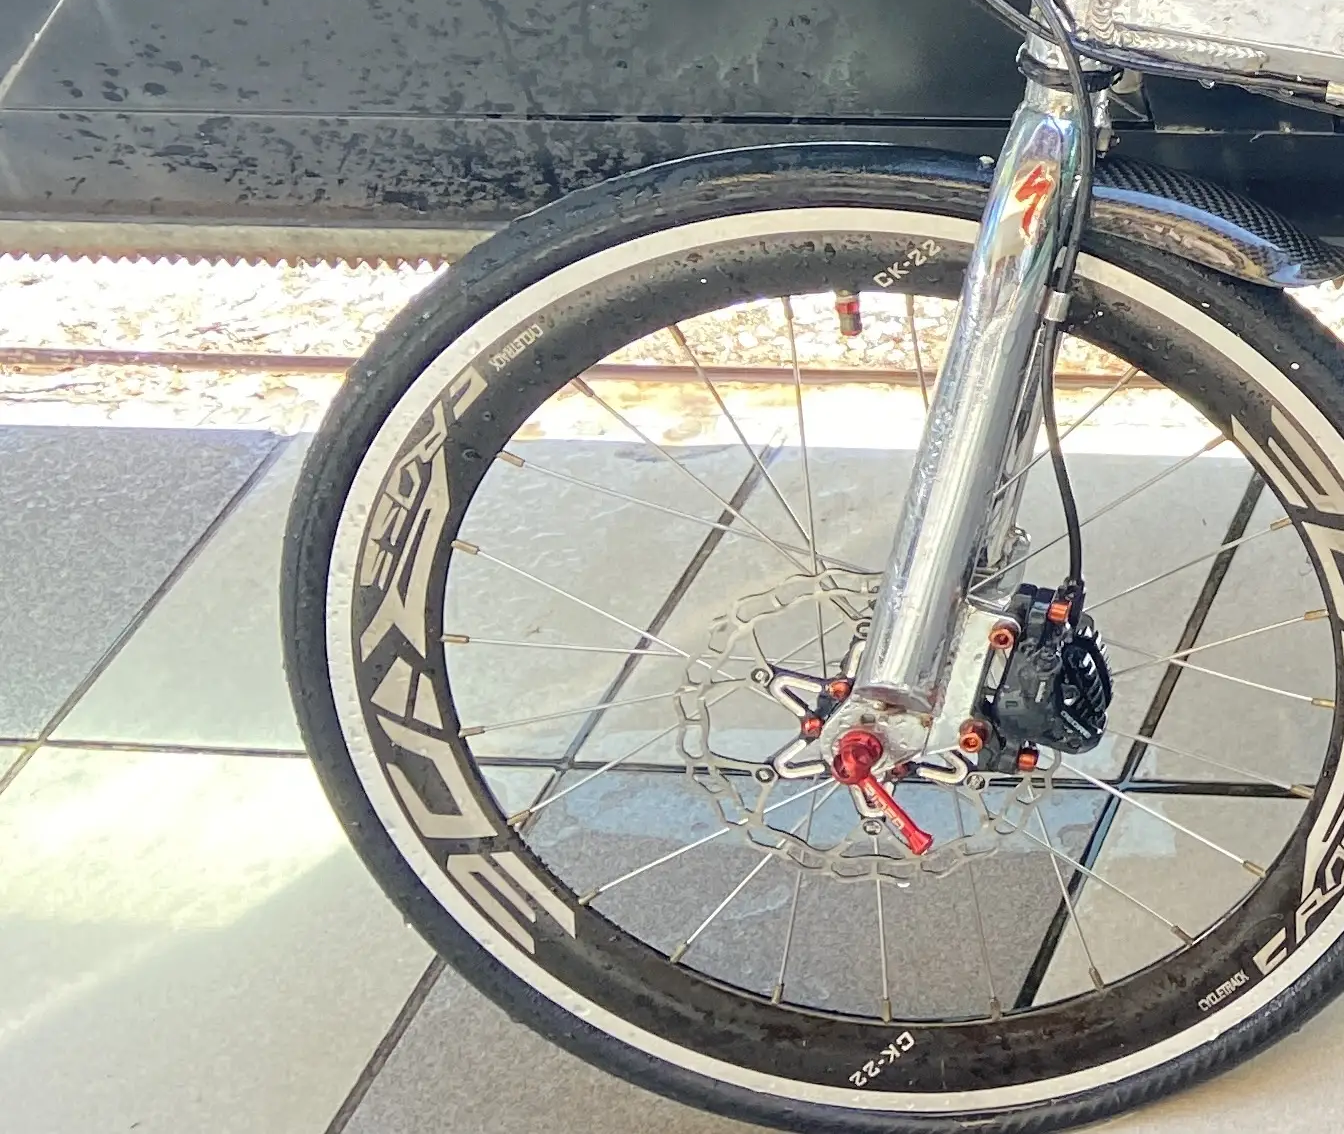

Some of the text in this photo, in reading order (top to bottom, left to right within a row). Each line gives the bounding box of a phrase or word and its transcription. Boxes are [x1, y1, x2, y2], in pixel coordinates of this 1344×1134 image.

[873, 239, 941, 289] CK-22
[1198, 969, 1250, 1013] CYCLETRACK
[848, 1030, 915, 1088] CK-22
